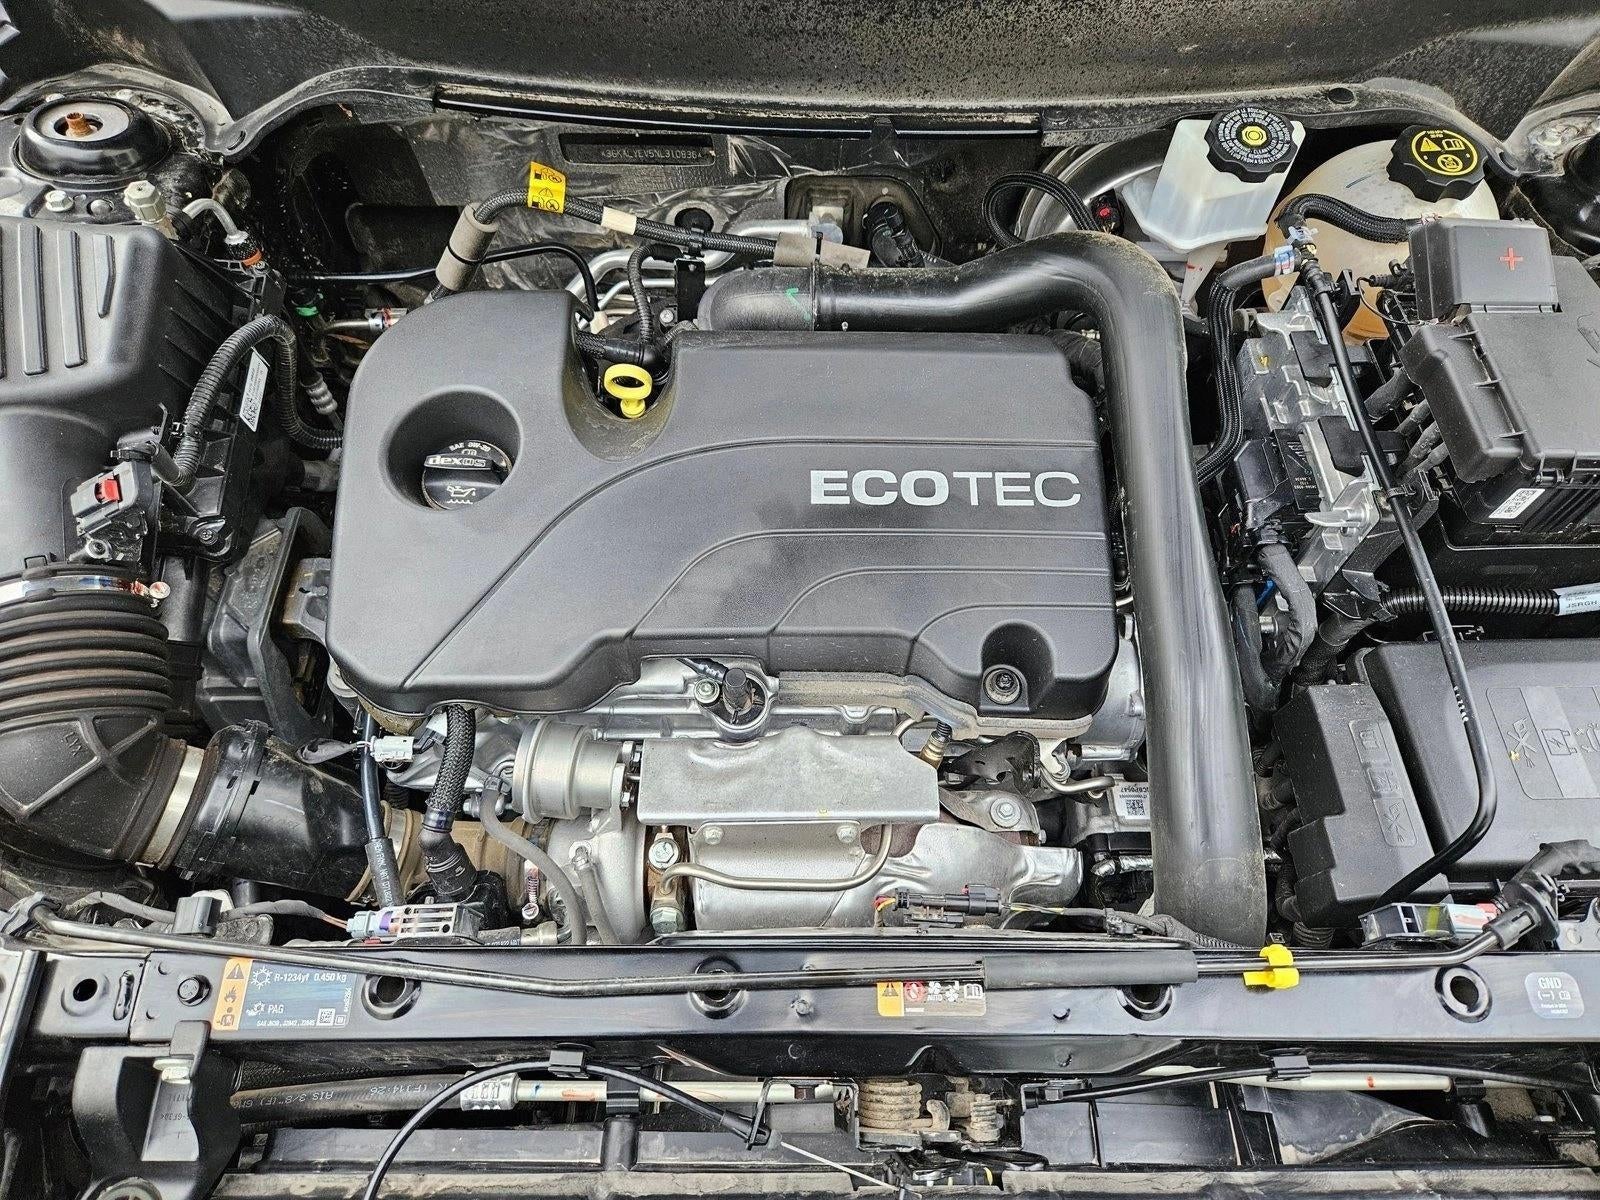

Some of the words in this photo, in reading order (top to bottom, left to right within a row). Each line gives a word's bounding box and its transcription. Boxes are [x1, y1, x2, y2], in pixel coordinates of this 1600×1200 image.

[428, 455, 487, 468] dexos
[810, 469, 1081, 507] ECOTEC
[274, 972, 310, 984] R-1234yf
[314, 972, 336, 982] 0.450
[336, 972, 347, 984] kg
[1537, 976, 1563, 989] GND
[267, 1004, 284, 1014] PAG
